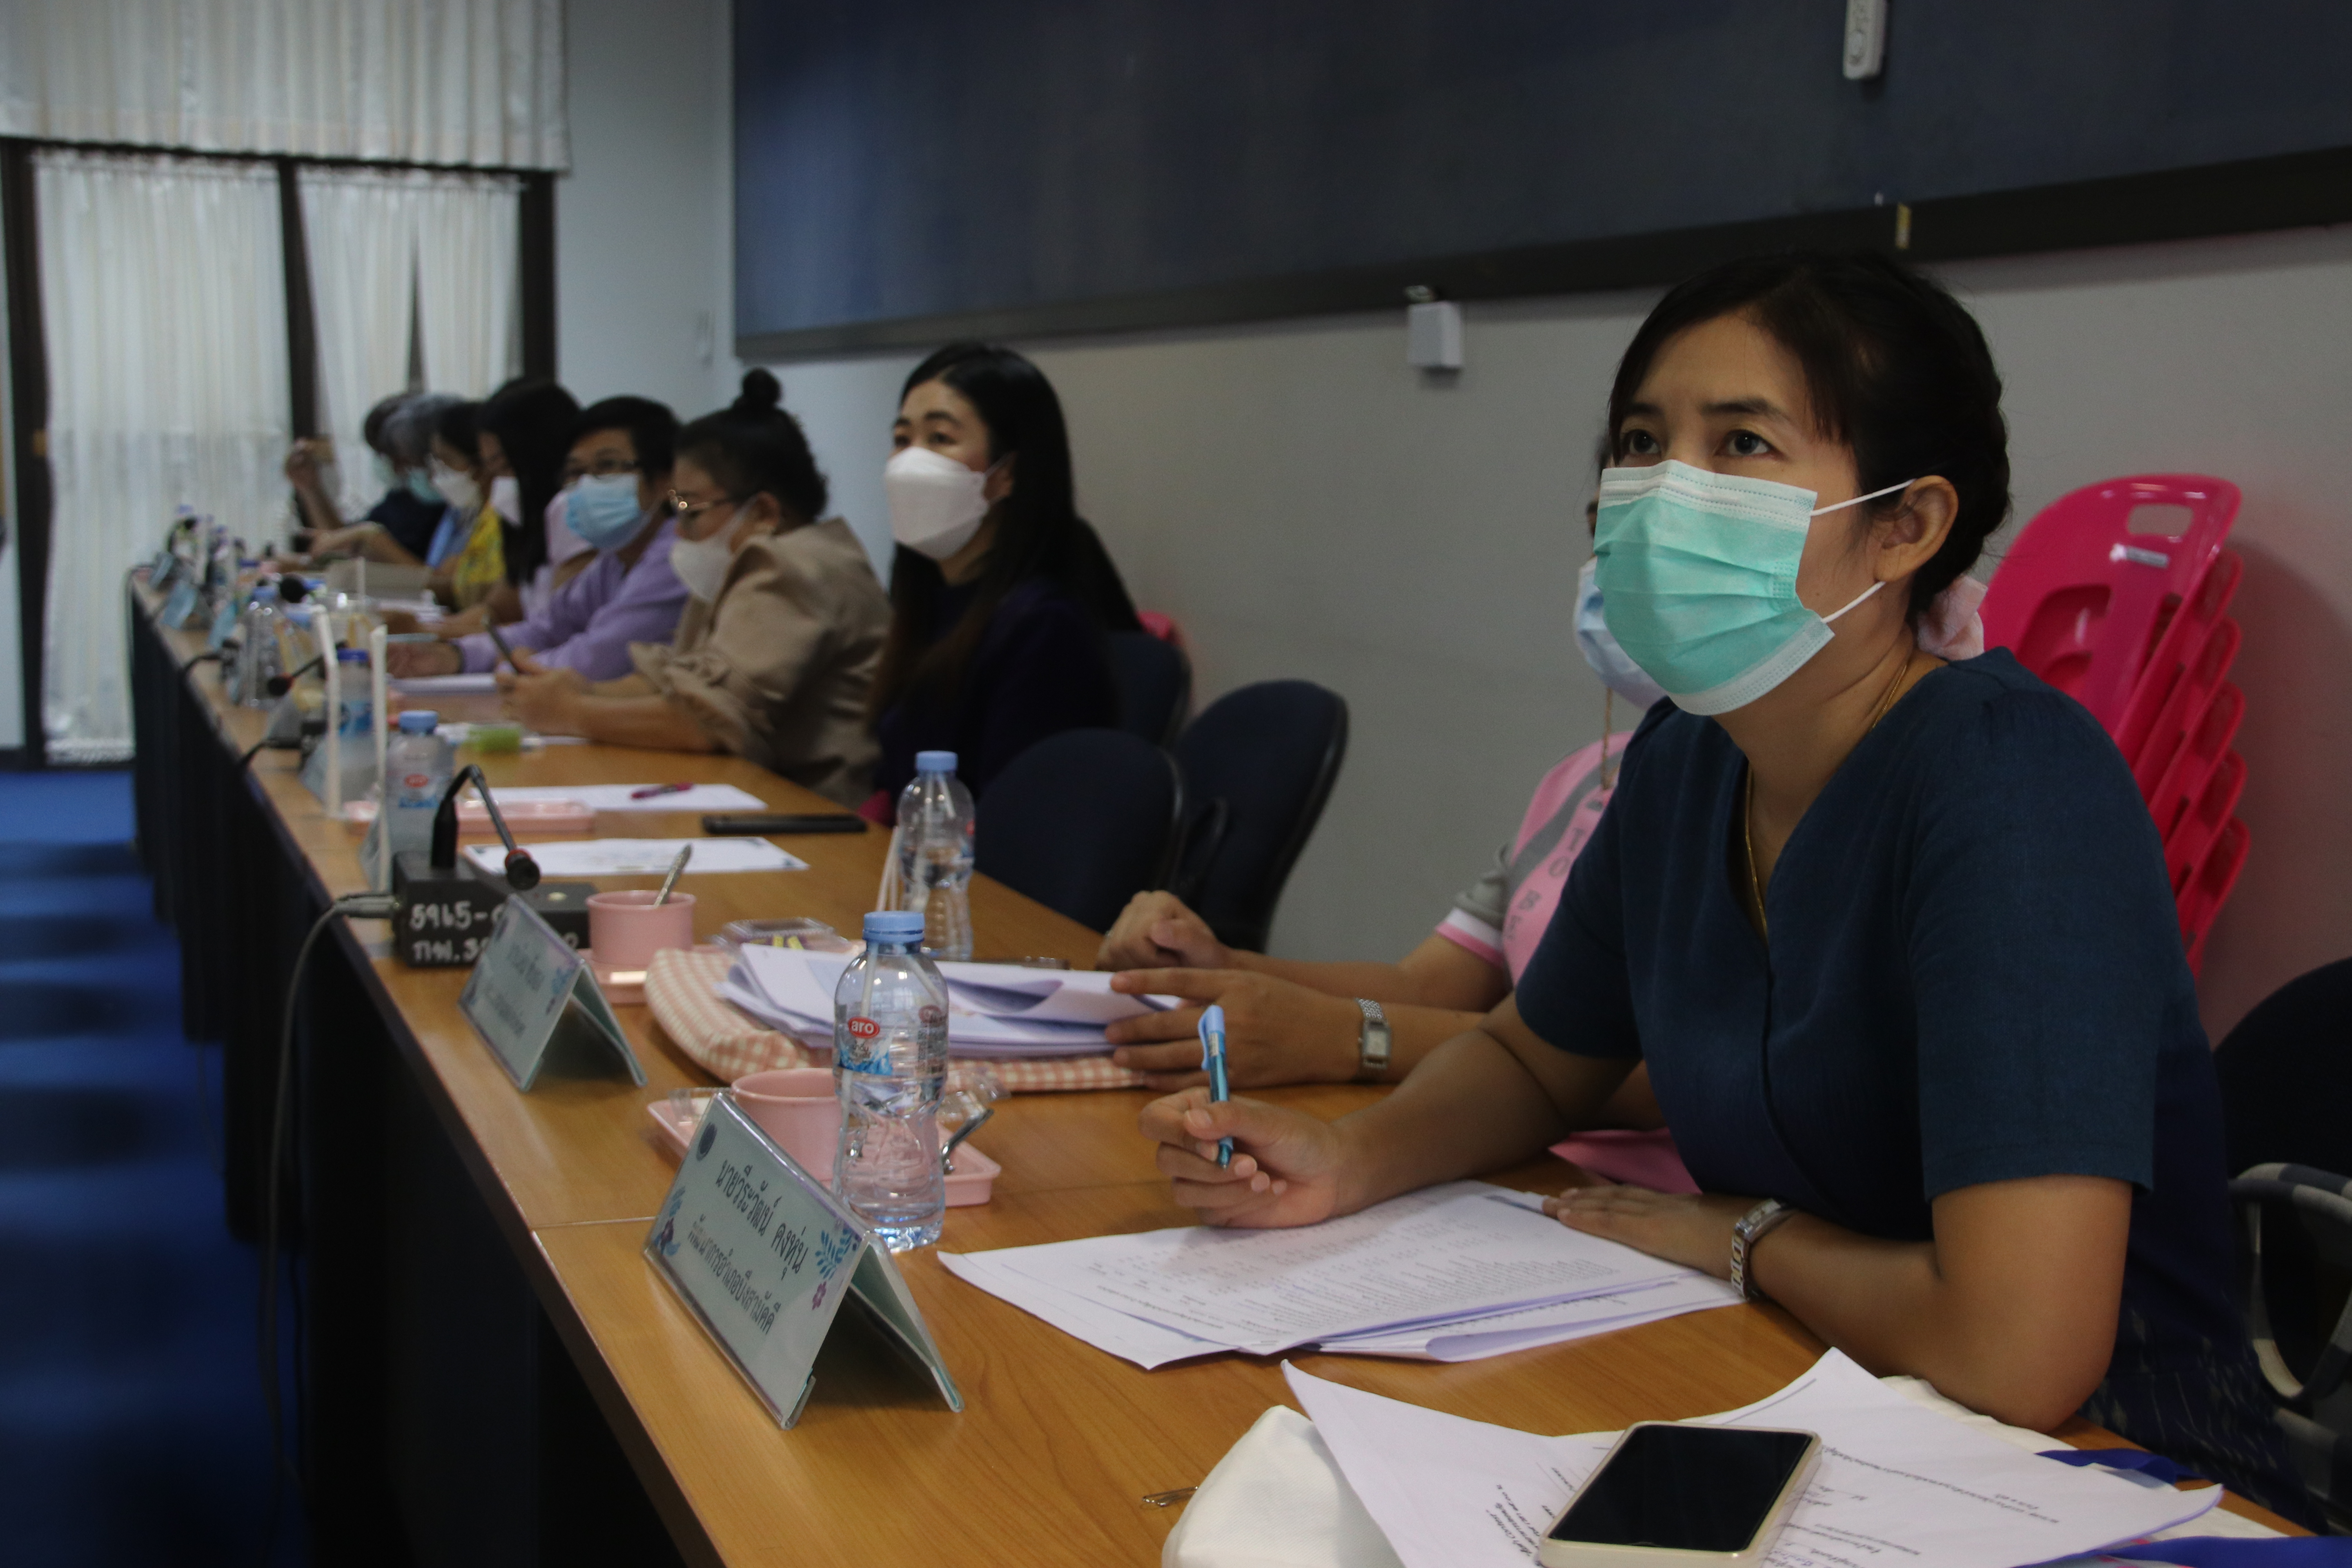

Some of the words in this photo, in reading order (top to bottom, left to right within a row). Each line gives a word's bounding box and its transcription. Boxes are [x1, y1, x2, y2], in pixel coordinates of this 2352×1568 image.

[851, 1020, 875, 1034] aro
[771, 1223, 808, 1281] คงหุ่น
